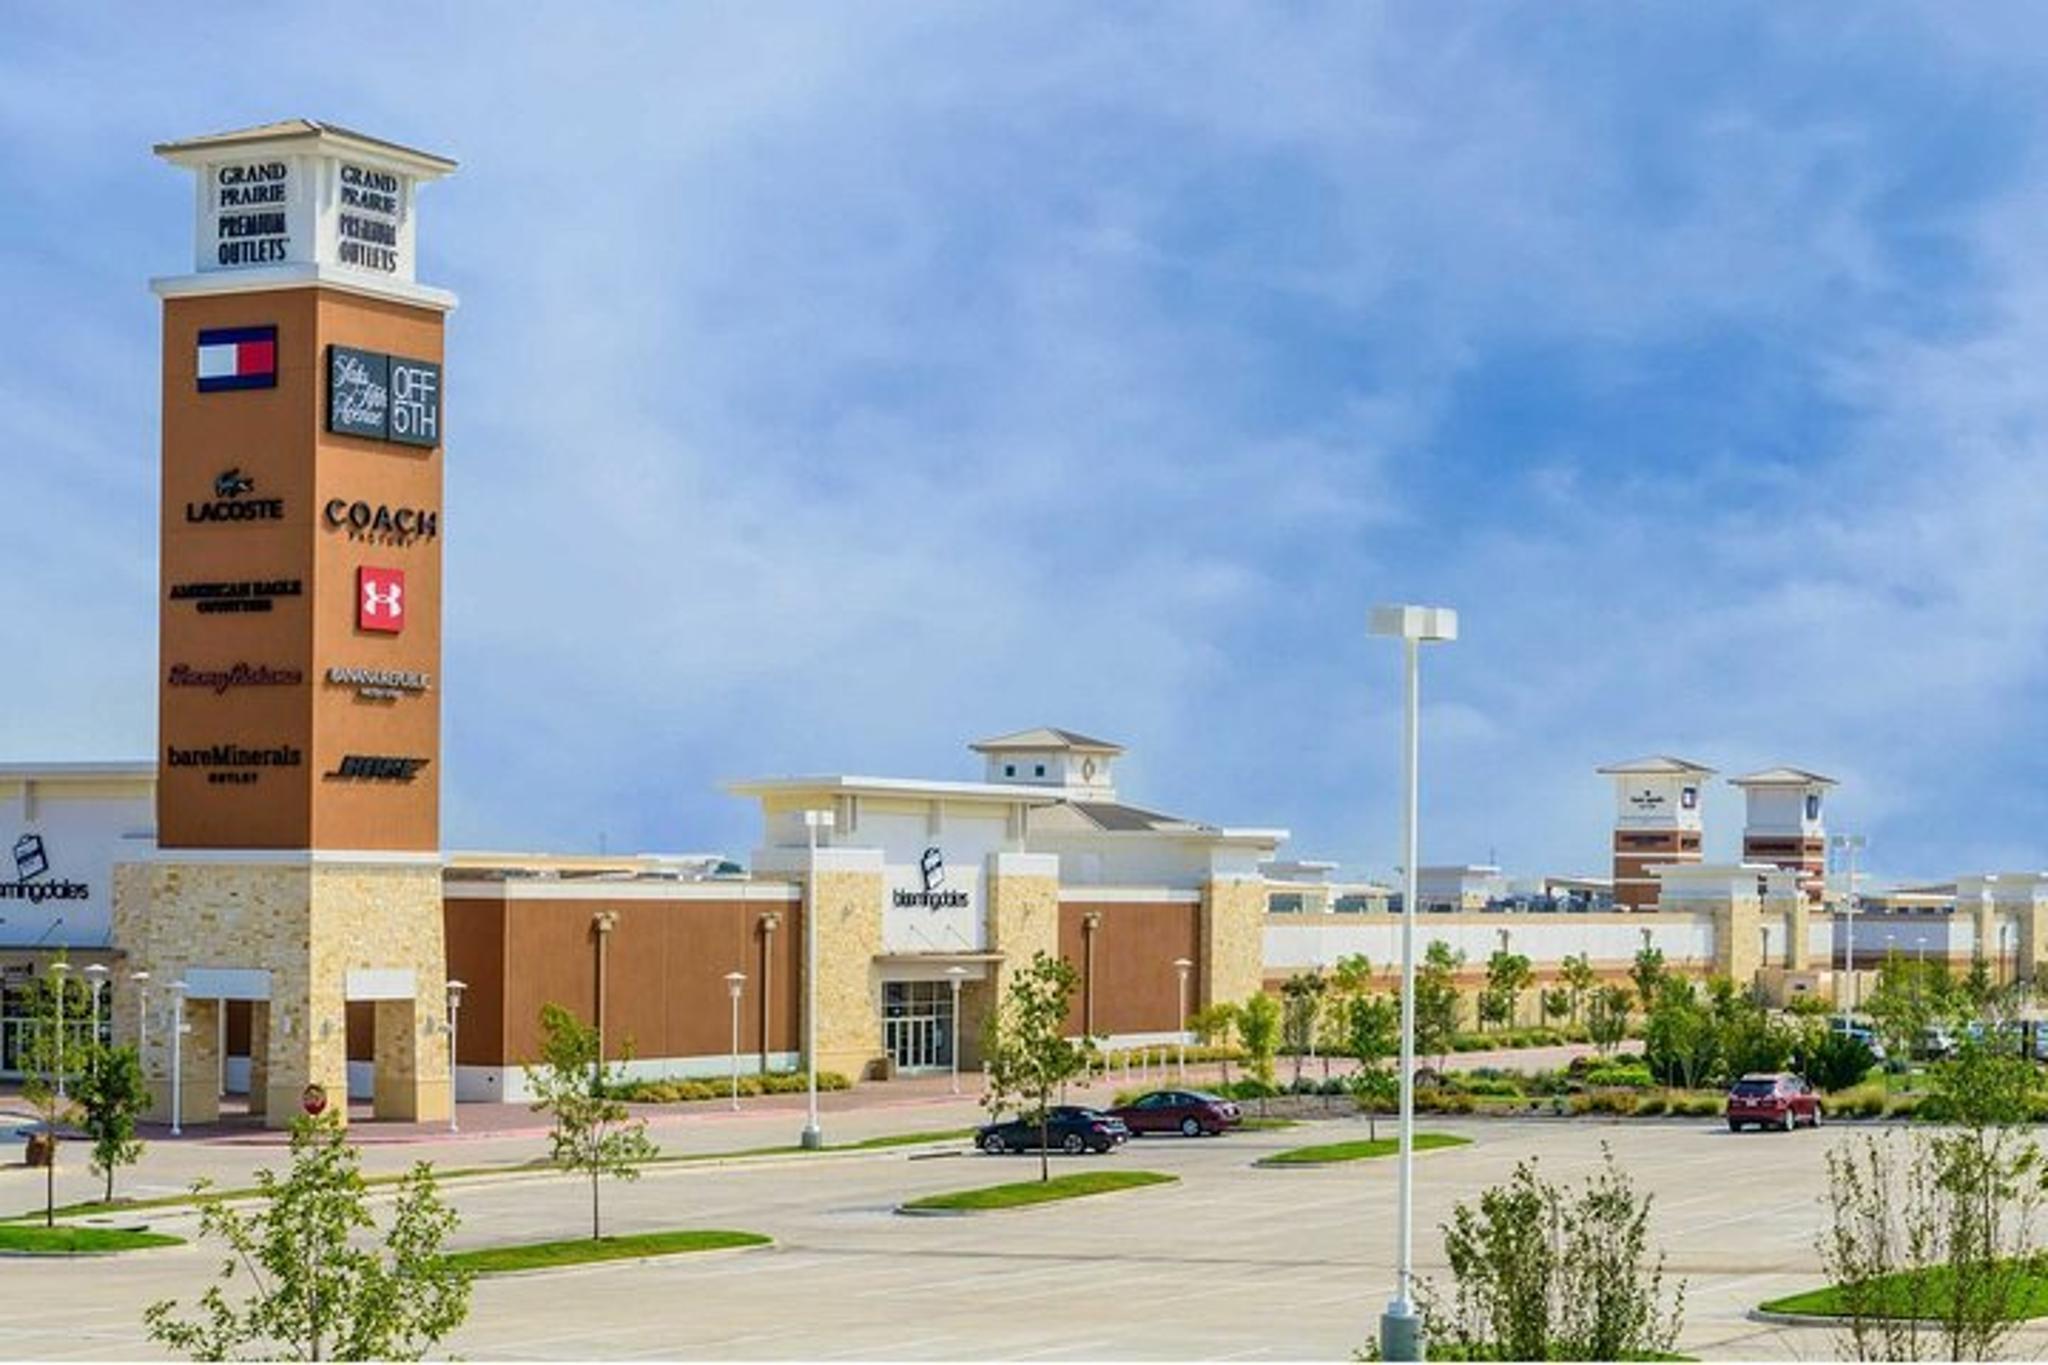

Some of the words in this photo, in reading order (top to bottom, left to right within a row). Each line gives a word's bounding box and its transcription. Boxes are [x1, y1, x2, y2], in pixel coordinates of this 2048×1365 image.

[219, 162, 287, 186] GRAND
[341, 164, 396, 192] GRAND
[220, 182, 286, 208] PRAIRIE
[341, 186, 396, 215] PRAIRIE
[218, 212, 286, 238] PREMIUM
[340, 213, 397, 247] PREMIUM
[218, 237, 289, 265] OUTLETS
[339, 240, 399, 273] OUTLETS
[394, 366, 436, 402] OFF
[394, 400, 436, 438] 5TH
[186, 499, 284, 523] LACOSTE
[325, 498, 436, 538] COACH
[167, 744, 302, 767] bareMinerals
